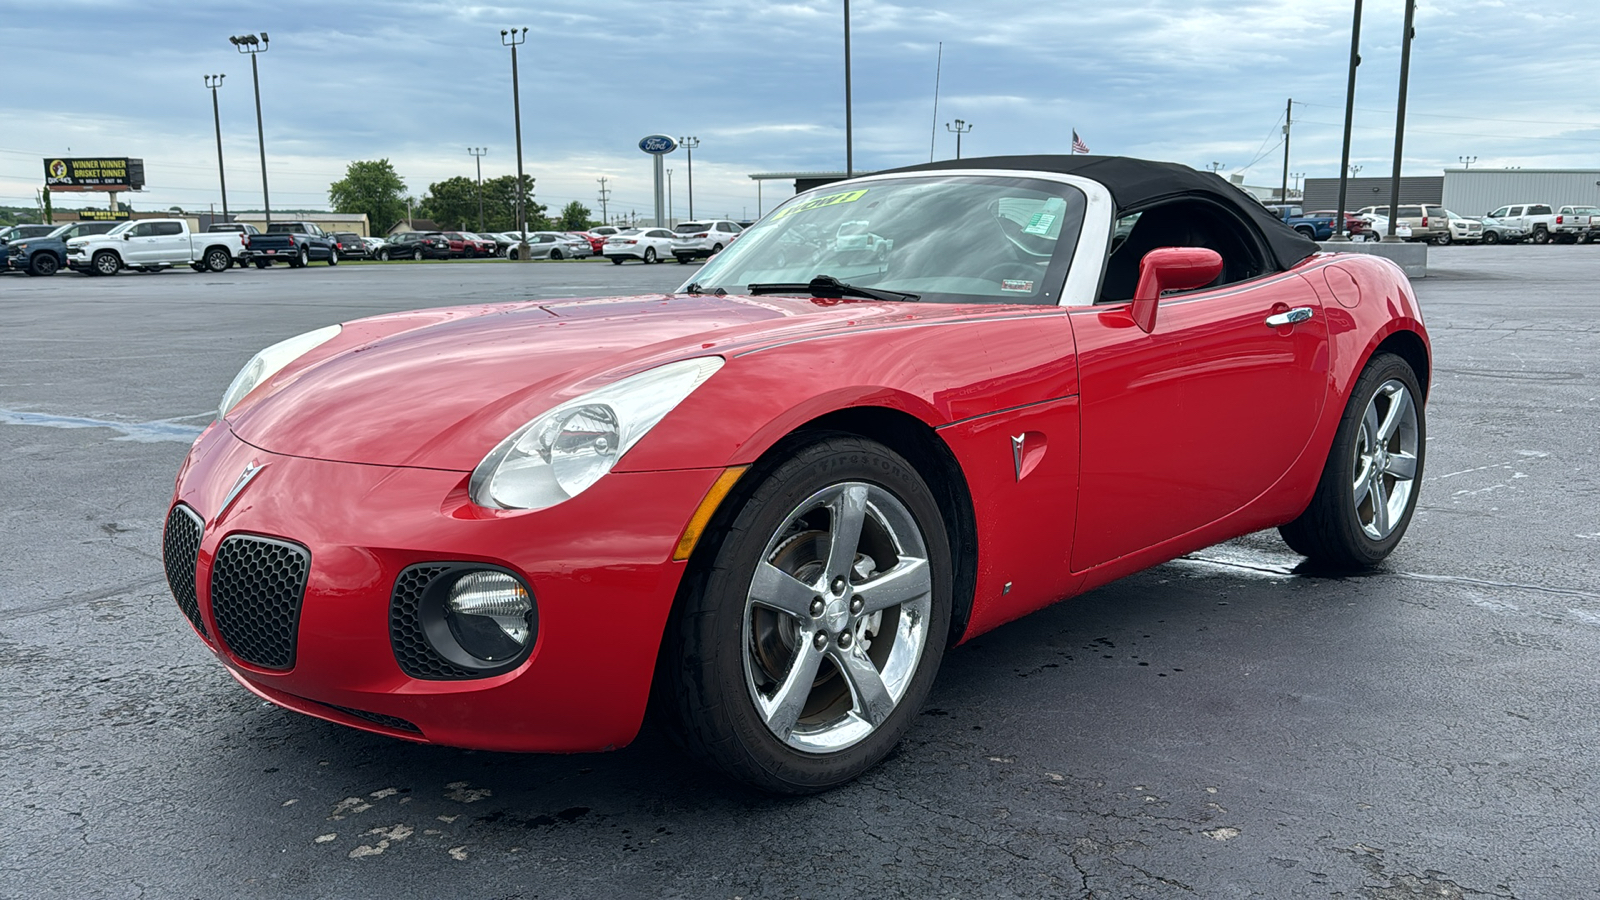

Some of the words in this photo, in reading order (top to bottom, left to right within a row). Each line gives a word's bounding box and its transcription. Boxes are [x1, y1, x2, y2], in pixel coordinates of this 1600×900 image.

[645, 138, 667, 150] Ford
[72, 160, 99, 168] WINNER
[100, 160, 126, 168] WINNER
[74, 169, 100, 177] BRISKET
[101, 169, 126, 177] DINNER
